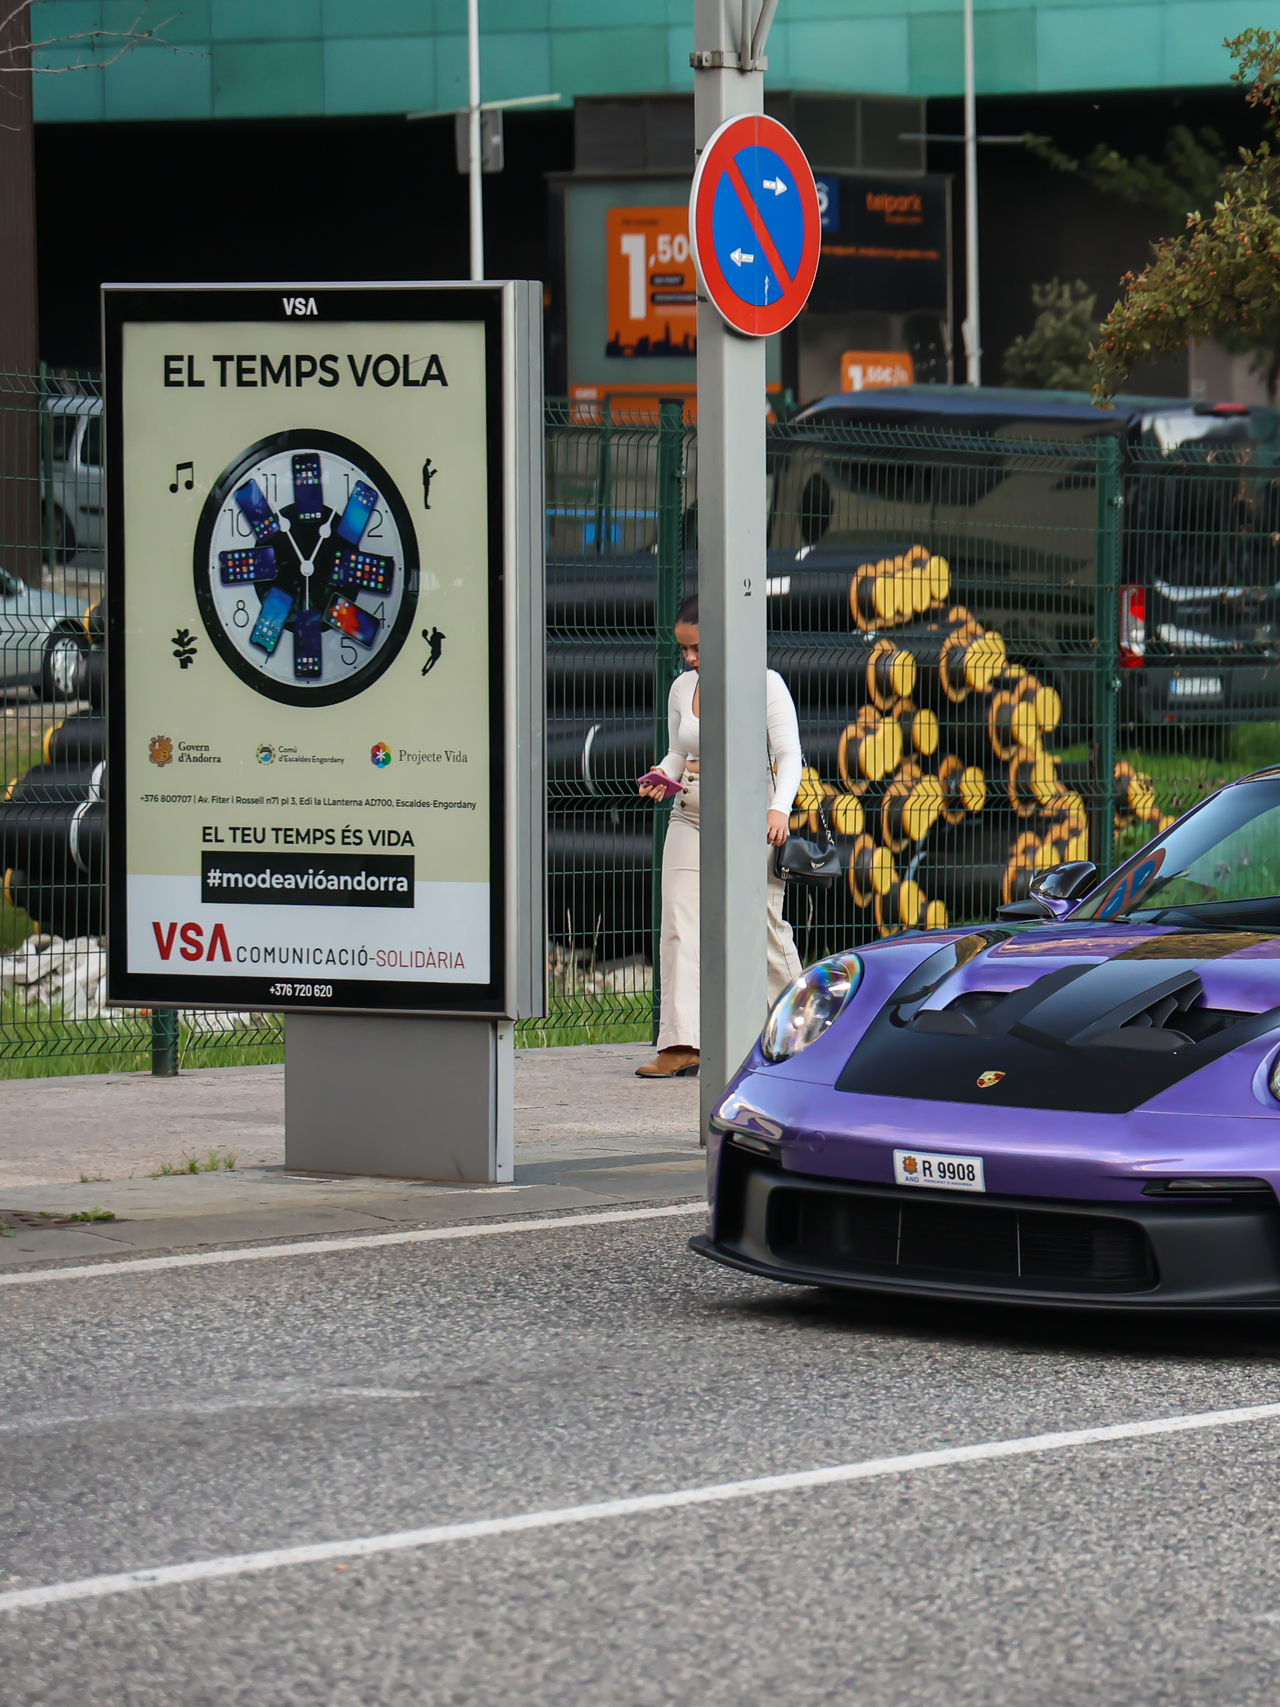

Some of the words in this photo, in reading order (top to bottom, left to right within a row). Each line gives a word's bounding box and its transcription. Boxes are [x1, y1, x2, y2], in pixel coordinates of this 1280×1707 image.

[620, 232, 692, 320] 1,50
[282, 297, 318, 315] VSA
[164, 354, 205, 388] EL
[213, 353, 340, 388] TEMPS
[347, 353, 449, 388] VOLA
[262, 474, 277, 502] 11
[367, 508, 383, 538] 2
[233, 599, 249, 628] 8
[341, 636, 358, 666] 5
[178, 741, 210, 752] Govern
[178, 752, 222, 763] d'Andorra
[278, 745, 298, 754] Comú
[399, 749, 442, 766] Projecte
[444, 750, 468, 763] Vida
[140, 794, 159, 803] +376
[160, 795, 192, 804] 800707
[197, 795, 210, 804] Av.
[211, 795, 230, 804] Fiter
[235, 796, 264, 805] Rossell
[281, 797, 289, 806] pl
[290, 797, 298, 806] 3,
[299, 797, 313, 806] Edi
[314, 797, 322, 806] la
[323, 798, 363, 807] LLanterna
[364, 799, 395, 808] AD700,
[396, 799, 477, 811] Escaldes-Engordany
[202, 826, 225, 843] EL
[229, 827, 266, 844] TEU
[271, 827, 336, 846] TEMPS
[341, 824, 363, 847] ÉS
[367, 829, 415, 847] VIDA
[206, 868, 409, 892] #modeavióandorra
[152, 921, 233, 962] VSA
[269, 983, 293, 996] +376
[294, 983, 313, 997] 720
[313, 984, 333, 998] 620
[922, 1160, 933, 1178] R
[937, 1161, 976, 1182] 9908
